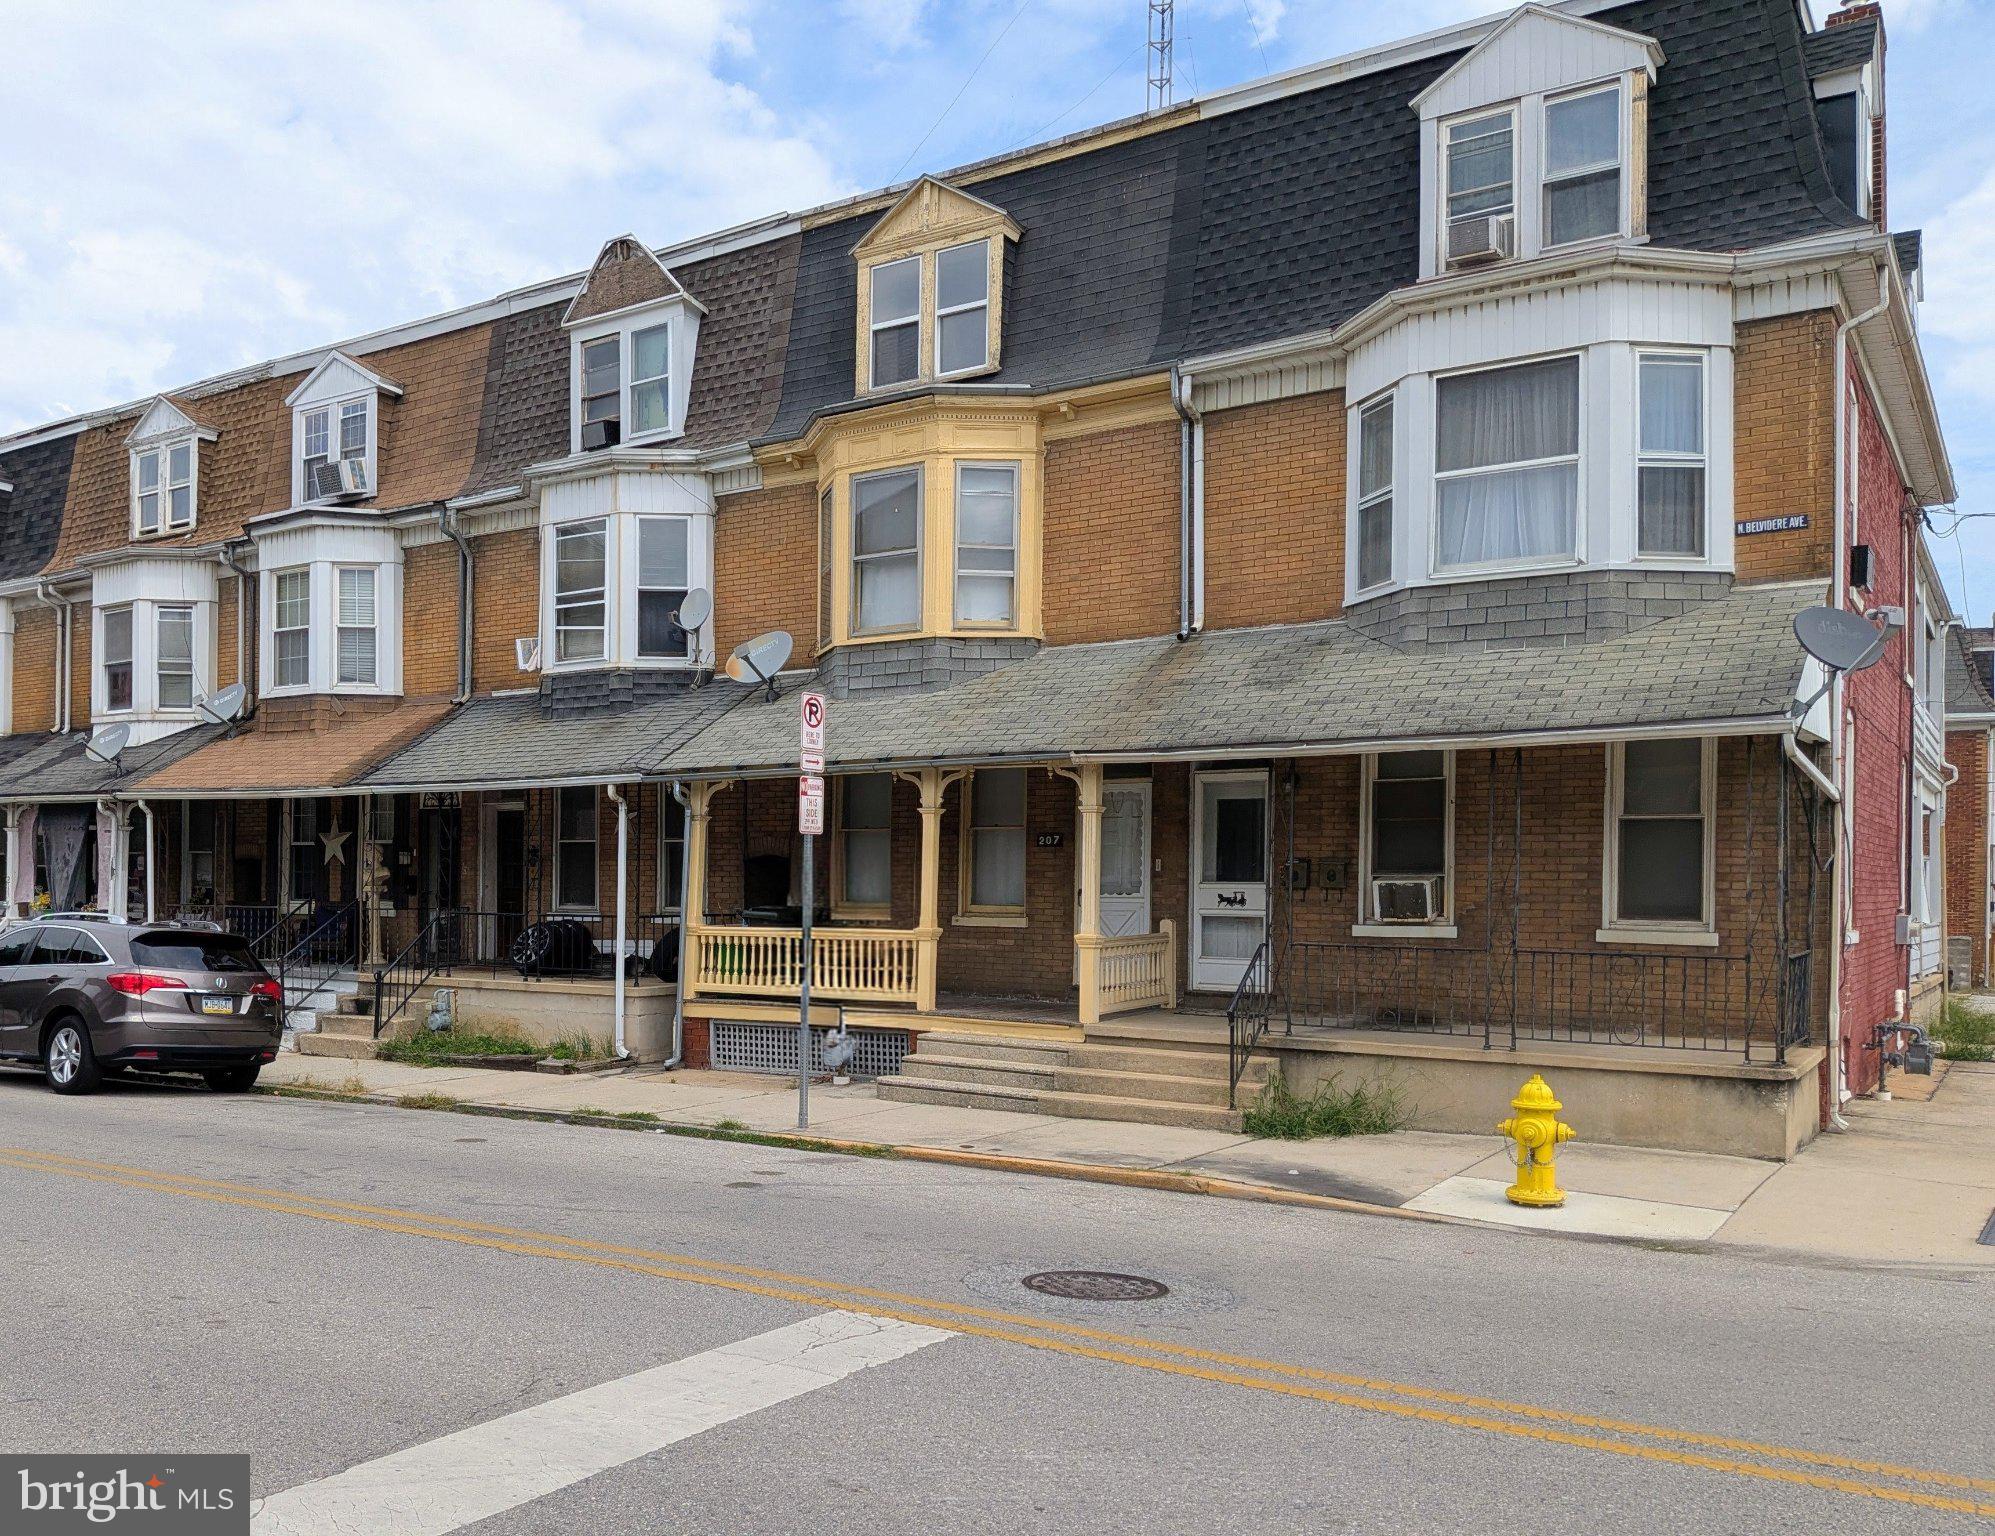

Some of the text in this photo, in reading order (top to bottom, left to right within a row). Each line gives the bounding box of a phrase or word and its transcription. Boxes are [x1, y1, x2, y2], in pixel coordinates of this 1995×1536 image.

[1737, 515, 1808, 534] N. BELVIDERE AVE.
[806, 798, 818, 807] THIS
[805, 808, 818, 818] SIDE
[1039, 835, 1060, 845] 207
